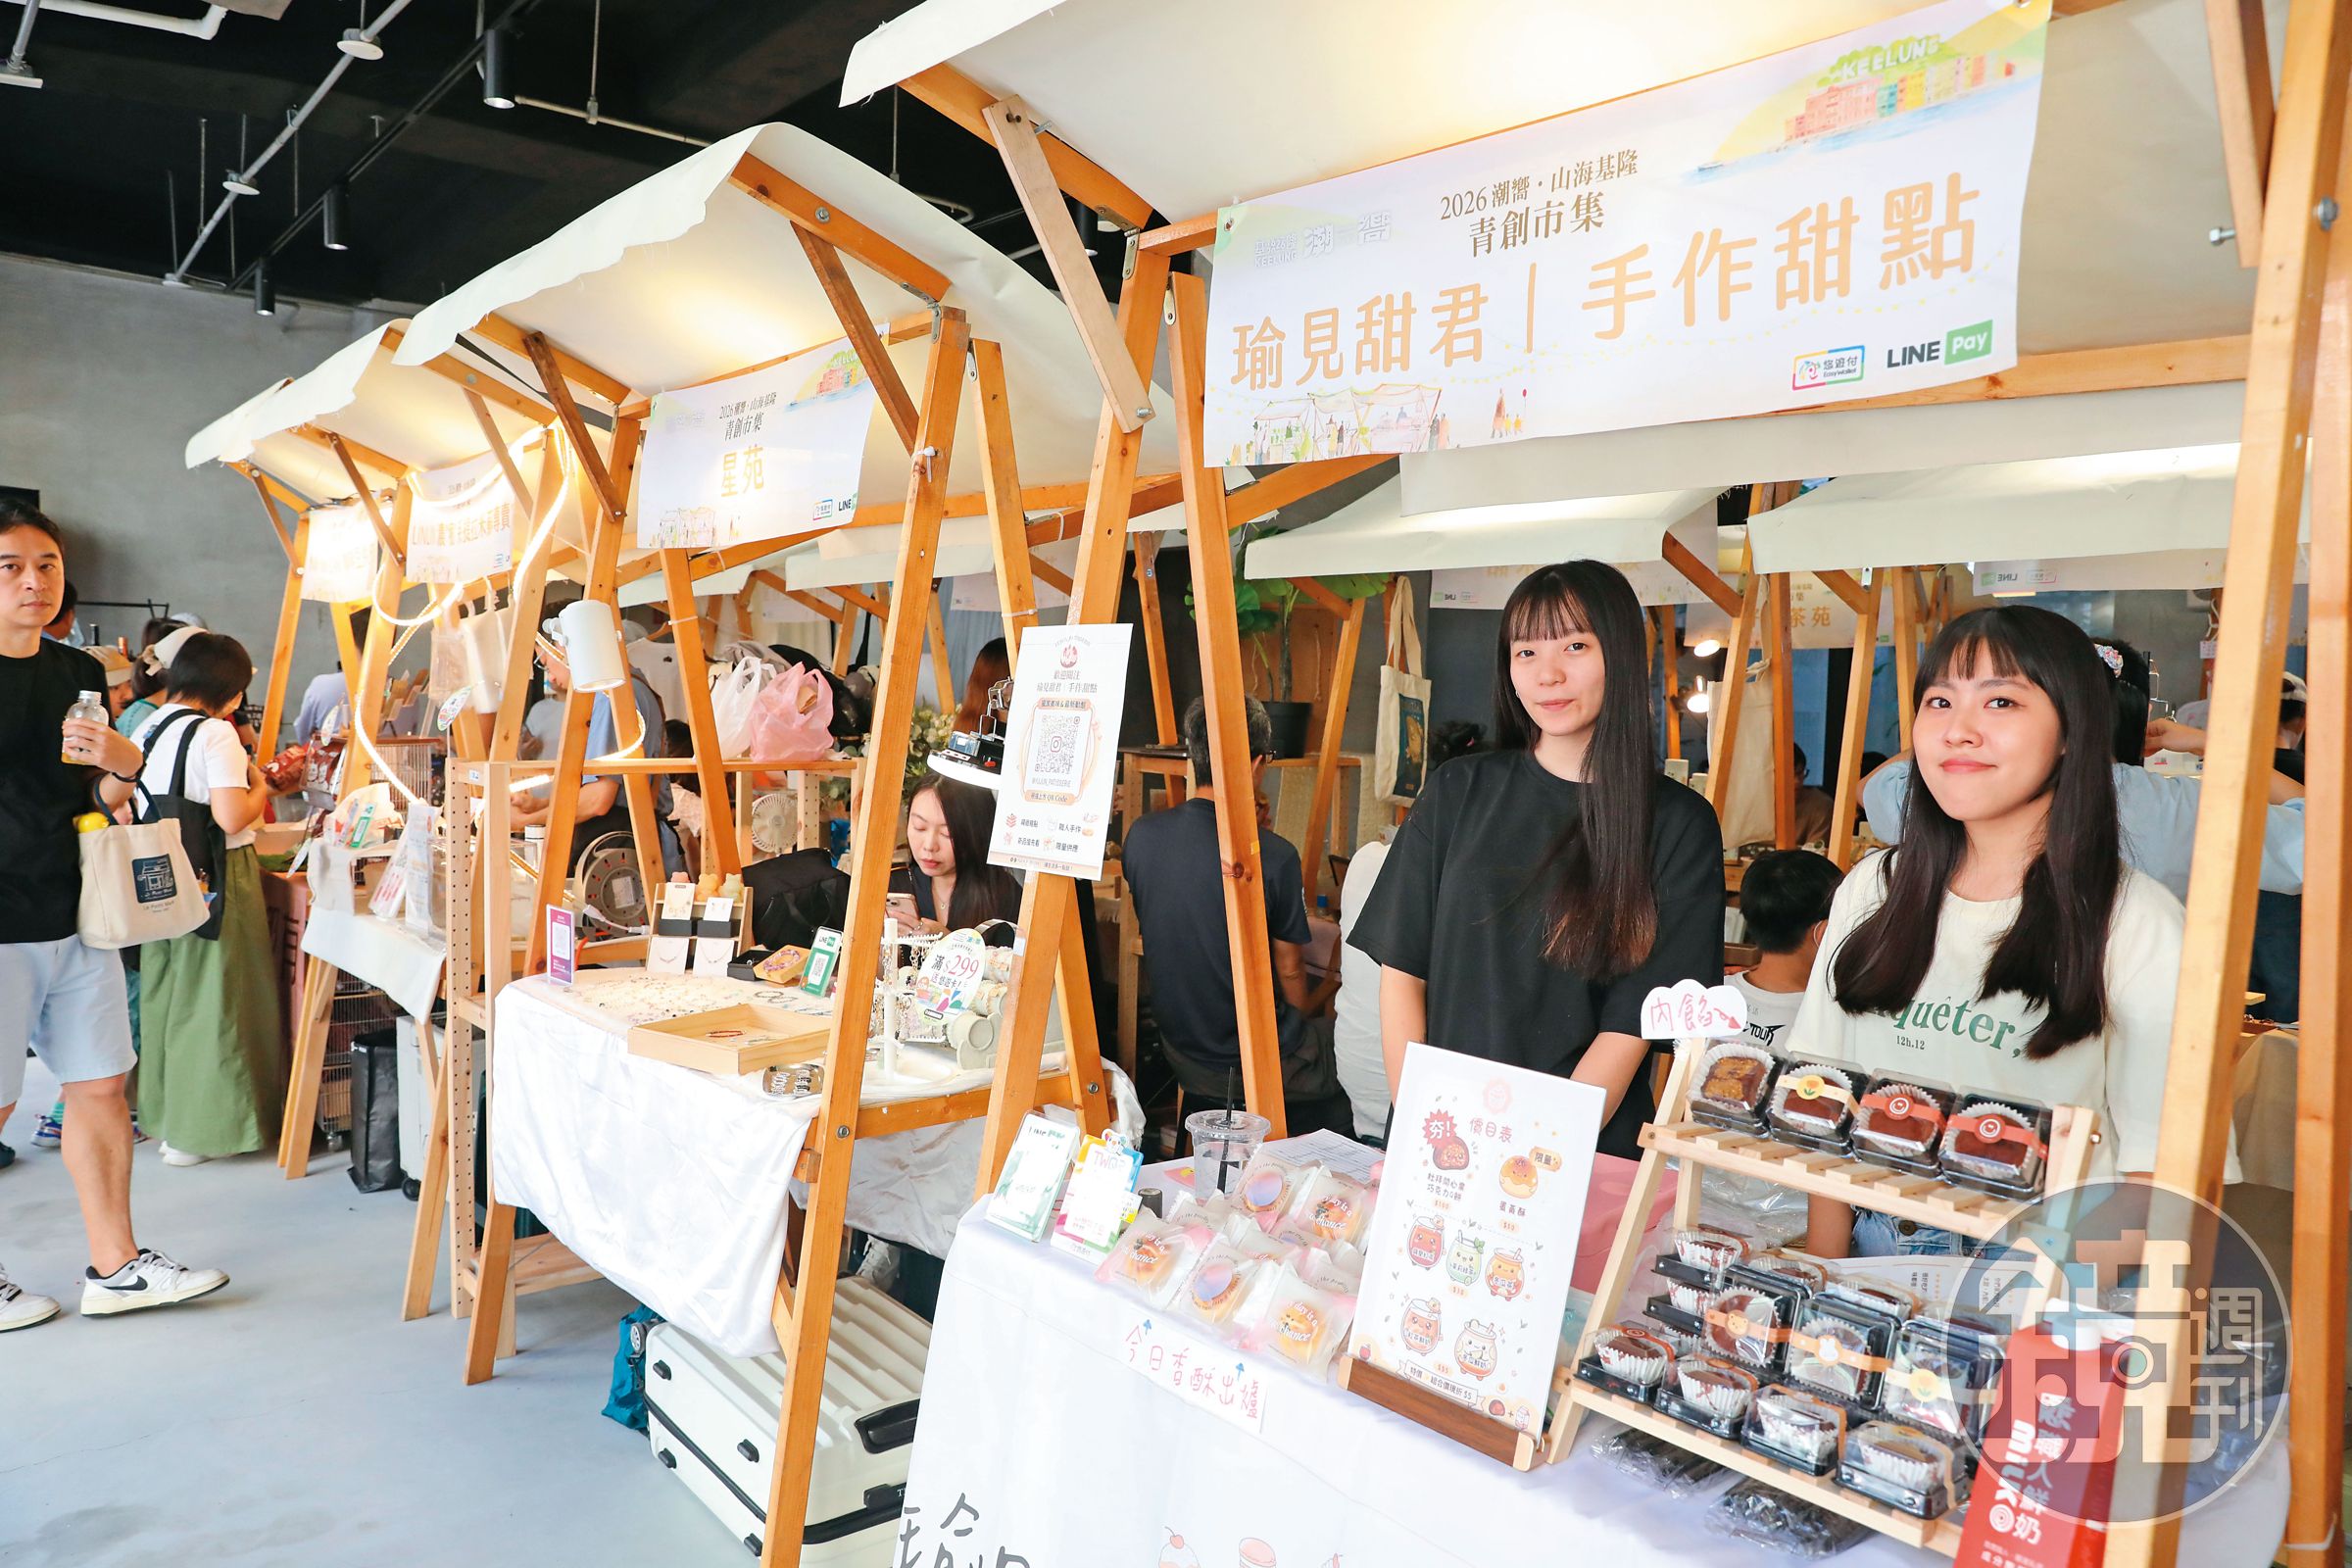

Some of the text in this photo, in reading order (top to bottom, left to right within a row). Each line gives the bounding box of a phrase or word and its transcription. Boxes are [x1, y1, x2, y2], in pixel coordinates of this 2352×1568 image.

[1441, 186, 1488, 220] 2026
[1469, 192, 1604, 258] 青創市集
[1231, 172, 1980, 391] 瑜見甜君 手作甜點
[1886, 332, 1987, 368] LINE Pay
[1823, 356, 1858, 370] 悠遊付
[724, 413, 764, 441] 青創市集
[720, 444, 765, 498] 星苑
[838, 499, 852, 512] LINE
[1896, 1035, 1926, 1051] 12h.12
[1430, 1120, 1450, 1139] 夯!
[1470, 1117, 1512, 1144] 價目表
[1535, 1152, 1552, 1165] 限量
[1499, 1200, 1526, 1217] 蛋黃酥
[1494, 1276, 1514, 1289] 冬瓜茶
